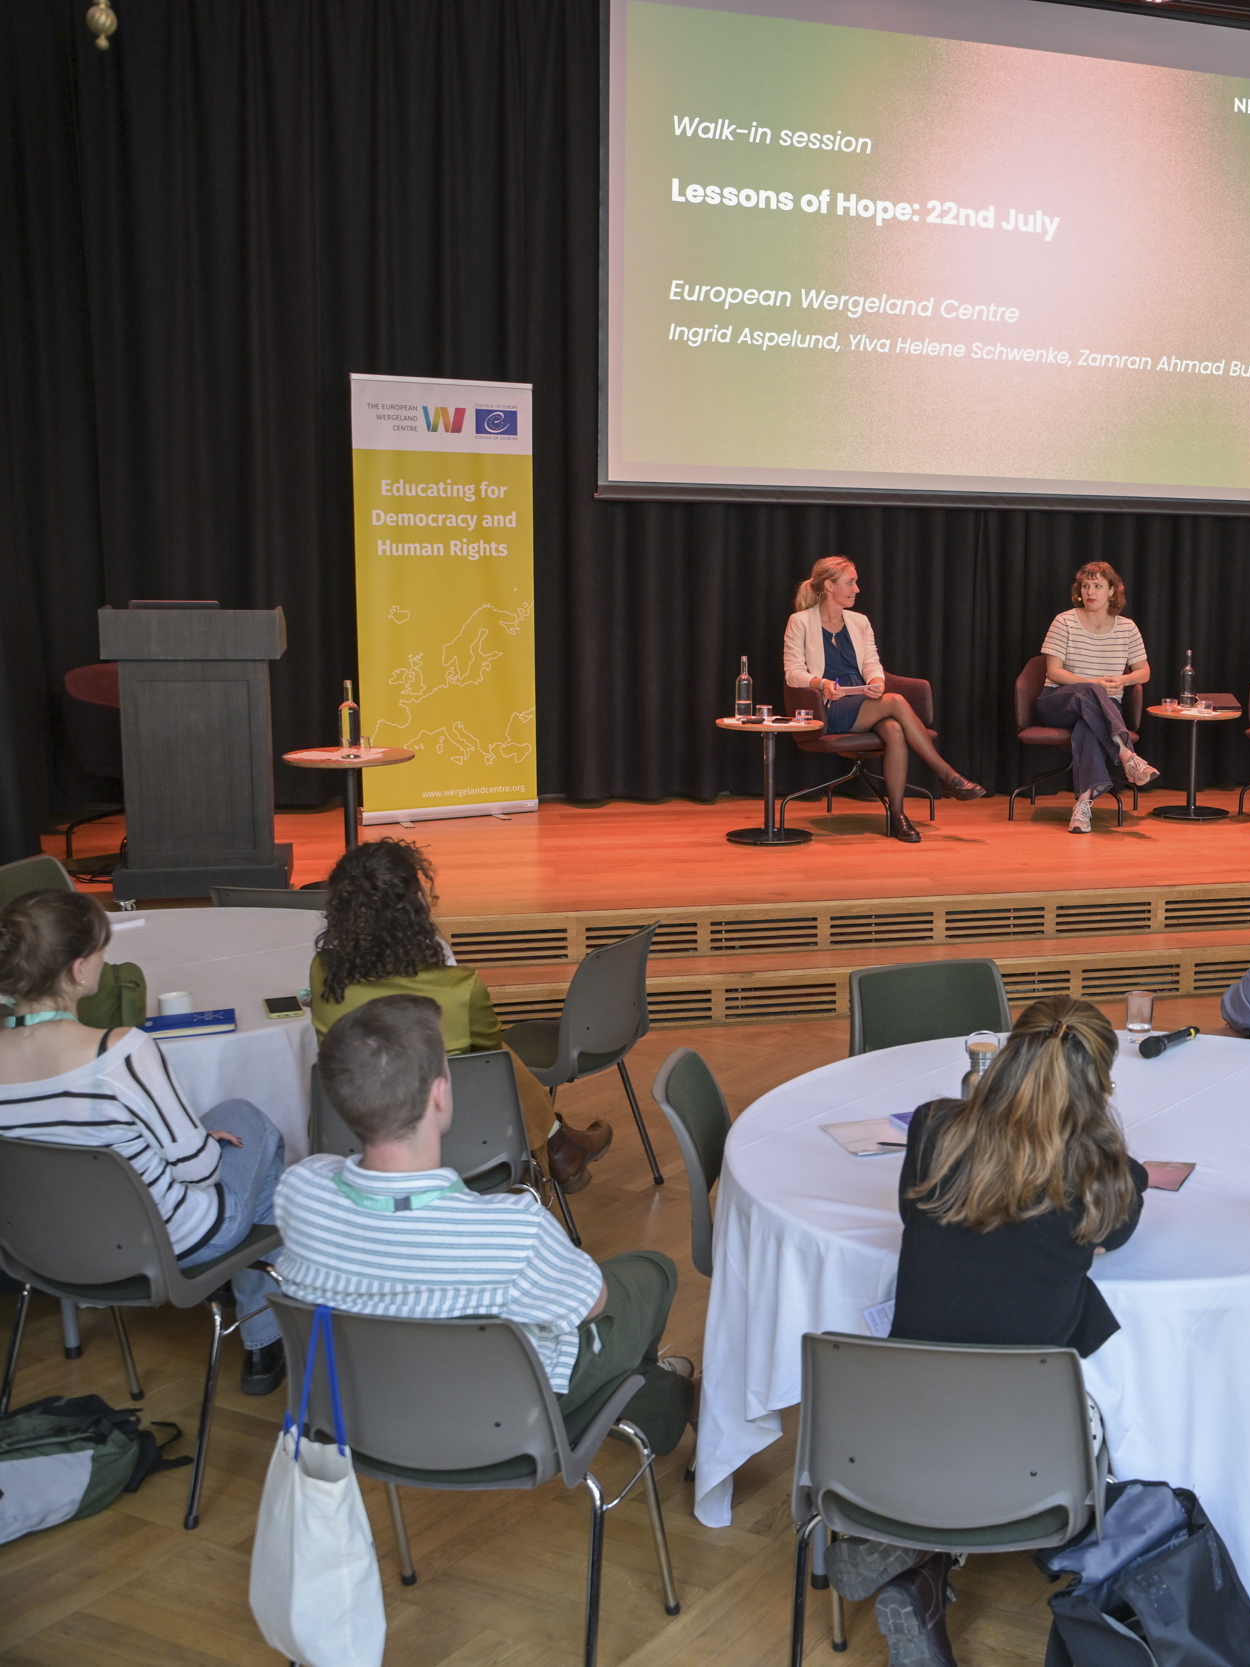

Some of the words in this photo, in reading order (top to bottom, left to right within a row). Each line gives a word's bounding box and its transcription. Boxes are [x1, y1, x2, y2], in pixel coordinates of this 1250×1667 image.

[673, 114, 772, 145] Walk-in
[778, 129, 873, 155] session
[671, 177, 795, 212] Lessons
[800, 188, 831, 215] of
[836, 192, 920, 227] Hope:
[926, 199, 995, 229] 22nd
[1001, 208, 1061, 241] July
[668, 279, 792, 310] European
[800, 288, 935, 319] Wergeland
[940, 299, 1019, 323] Centre
[668, 322, 734, 348] Ingrid
[736, 327, 842, 353] Aspelund,
[849, 333, 891, 353] Ylva
[895, 337, 966, 358] Helene
[971, 342, 1072, 367] Schwenke,
[1077, 349, 1152, 370] Zamran
[1155, 354, 1226, 376] Ahmad
[375, 413, 418, 422] WERGELAND
[381, 403, 418, 412] EUROPEAN
[381, 478, 476, 502] Educating
[479, 481, 508, 498] for
[371, 509, 478, 531] Democracy
[482, 511, 517, 528] and
[377, 539, 444, 556] Human
[450, 538, 508, 560] Rights
[421, 784, 526, 798] www.wergelandcentre.org
